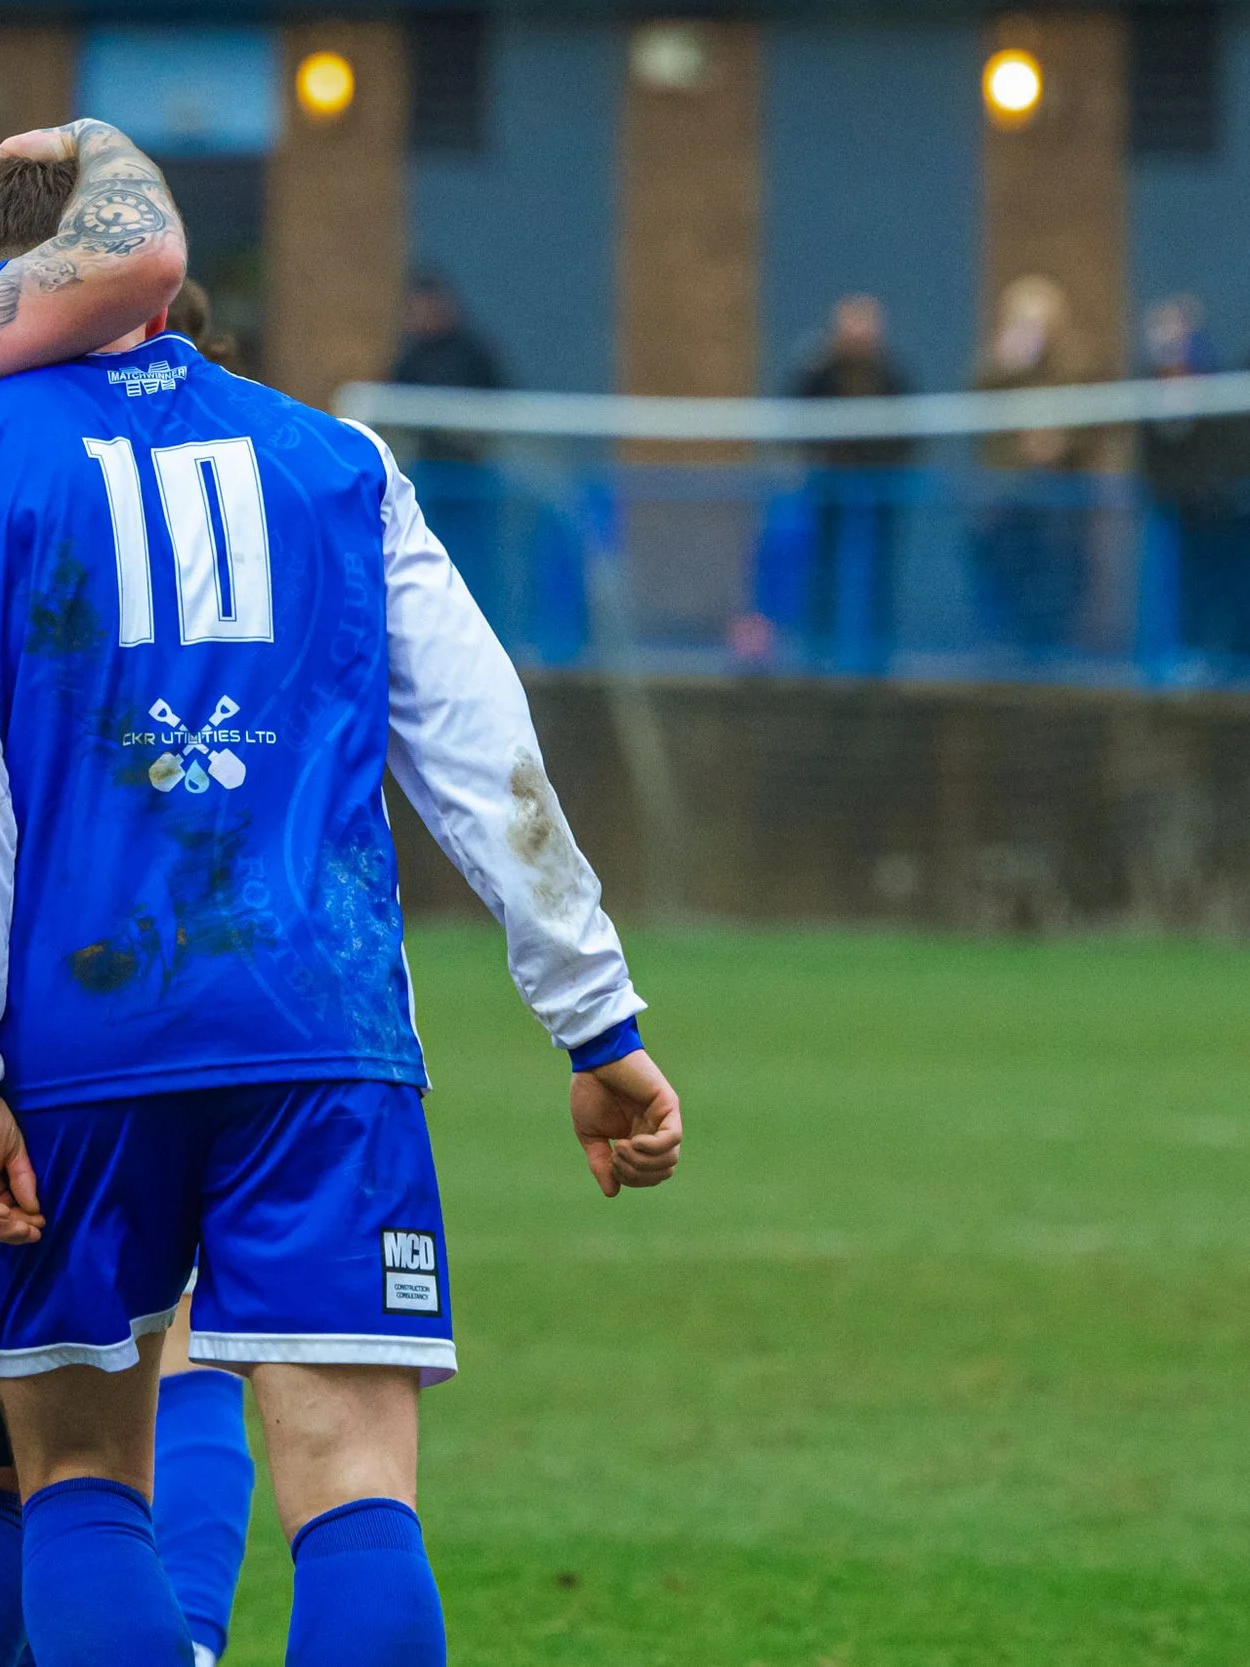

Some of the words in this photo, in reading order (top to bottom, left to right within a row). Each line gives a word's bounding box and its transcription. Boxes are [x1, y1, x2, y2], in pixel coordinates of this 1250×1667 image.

[111, 368, 185, 381] MATCHWINNER
[82, 436, 274, 647] 10
[161, 730, 240, 744] UTILITIES
[245, 731, 277, 744] LTD
[383, 1231, 435, 1270] MCD
[394, 1283, 430, 1292] CONSTRUCTION
[396, 1291, 429, 1301] CONSULTANCY
